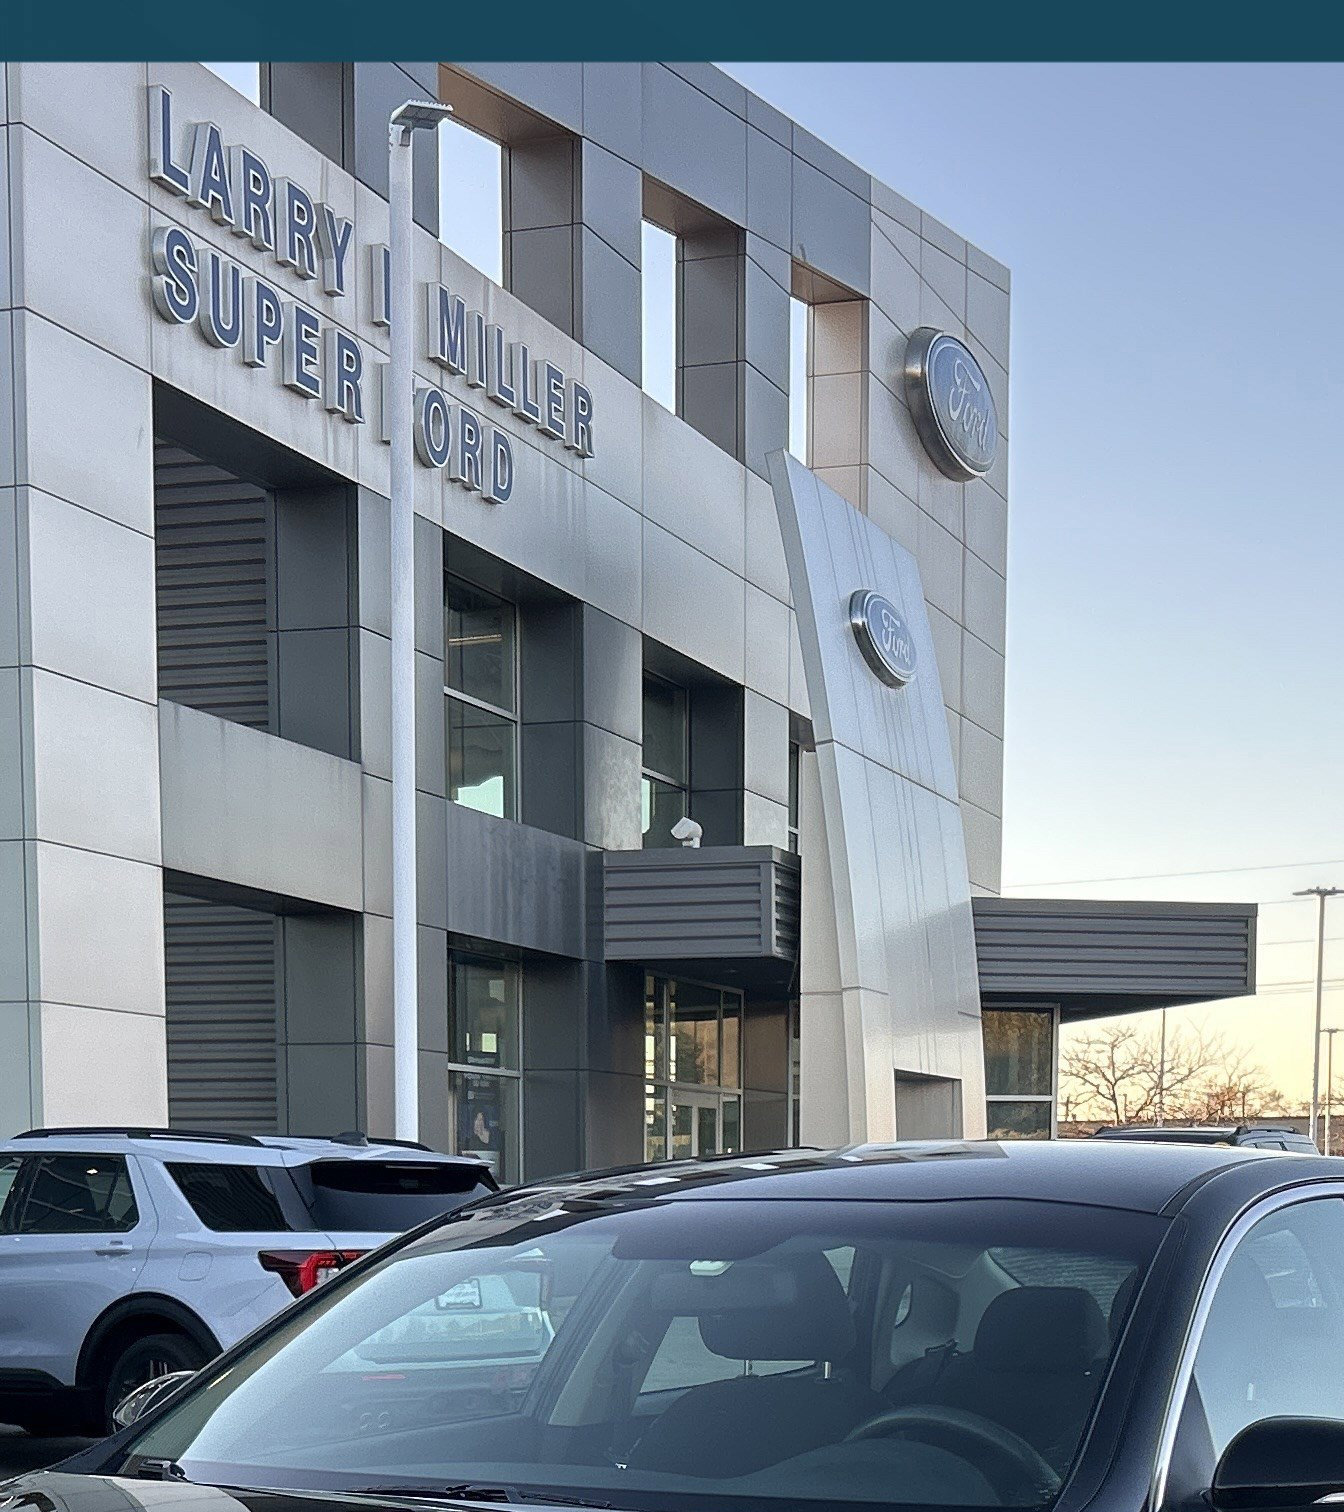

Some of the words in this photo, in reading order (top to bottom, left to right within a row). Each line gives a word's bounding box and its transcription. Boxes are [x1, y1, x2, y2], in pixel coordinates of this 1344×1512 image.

[149, 84, 355, 297] LARRY
[427, 281, 595, 458] MILLER
[153, 225, 365, 425] SUPER
[949, 358, 990, 451] Ford
[881, 608, 912, 668] Ford
